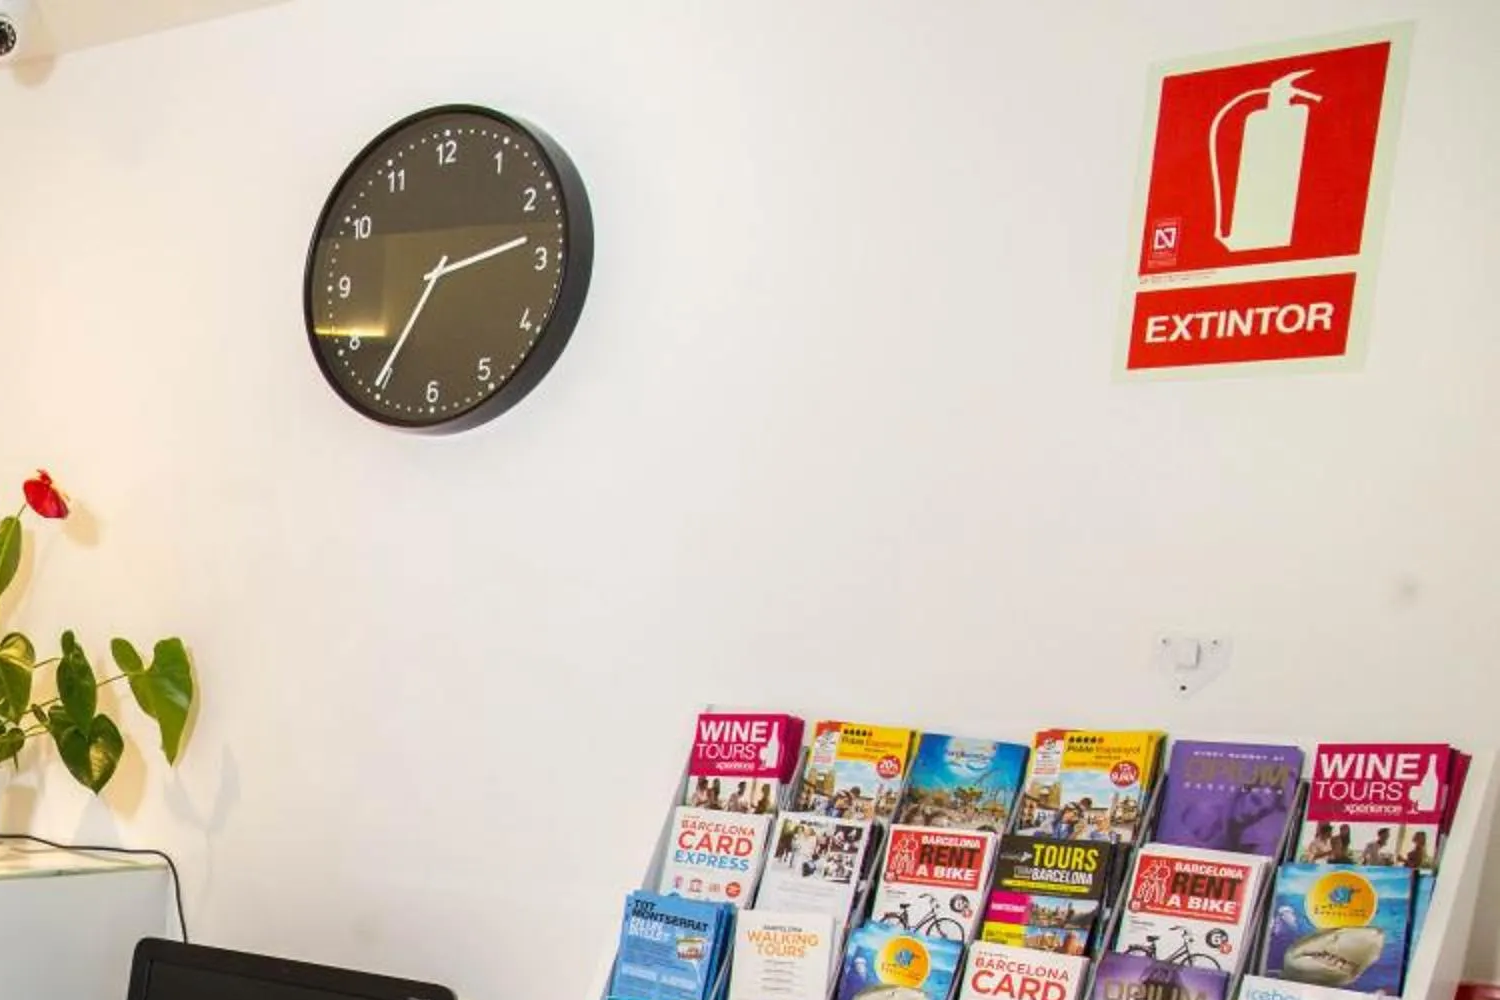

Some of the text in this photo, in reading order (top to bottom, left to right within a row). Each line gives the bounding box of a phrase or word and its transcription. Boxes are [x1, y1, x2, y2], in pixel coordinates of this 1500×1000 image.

[436, 140, 457, 165] 12
[493, 151, 504, 174] 1
[387, 169, 405, 192] 11
[522, 188, 537, 211] 2
[352, 215, 371, 240] 10
[534, 246, 547, 271] 3
[338, 276, 350, 298] 9
[519, 308, 532, 331] 4
[1144, 301, 1334, 344] EXTINTOR
[478, 358, 491, 380] 5
[426, 381, 439, 403] 6
[700, 720, 769, 743] WINE
[696, 743, 757, 759] TOURS
[1319, 753, 1420, 780] WINE
[1315, 781, 1403, 801] TOURS
[1344, 804, 1402, 816] xperience
[681, 819, 755, 836] BARCELONA
[677, 830, 753, 857] CARD
[921, 834, 981, 849] BARCELONA
[674, 850, 750, 872] EXPRESS
[918, 845, 982, 867] RENT
[1032, 843, 1100, 871] TOURS
[916, 864, 977, 881] A BIKE
[1031, 867, 1093, 885] BARCELONA
[1175, 861, 1244, 878] BARCELONA
[1171, 872, 1241, 901] RENT
[1166, 895, 1237, 915] A BIKE
[631, 907, 709, 932] MONTSERRAT
[748, 929, 818, 948] WALKING
[757, 942, 805, 958] TOURS
[974, 956, 1070, 981] BARCELONA
